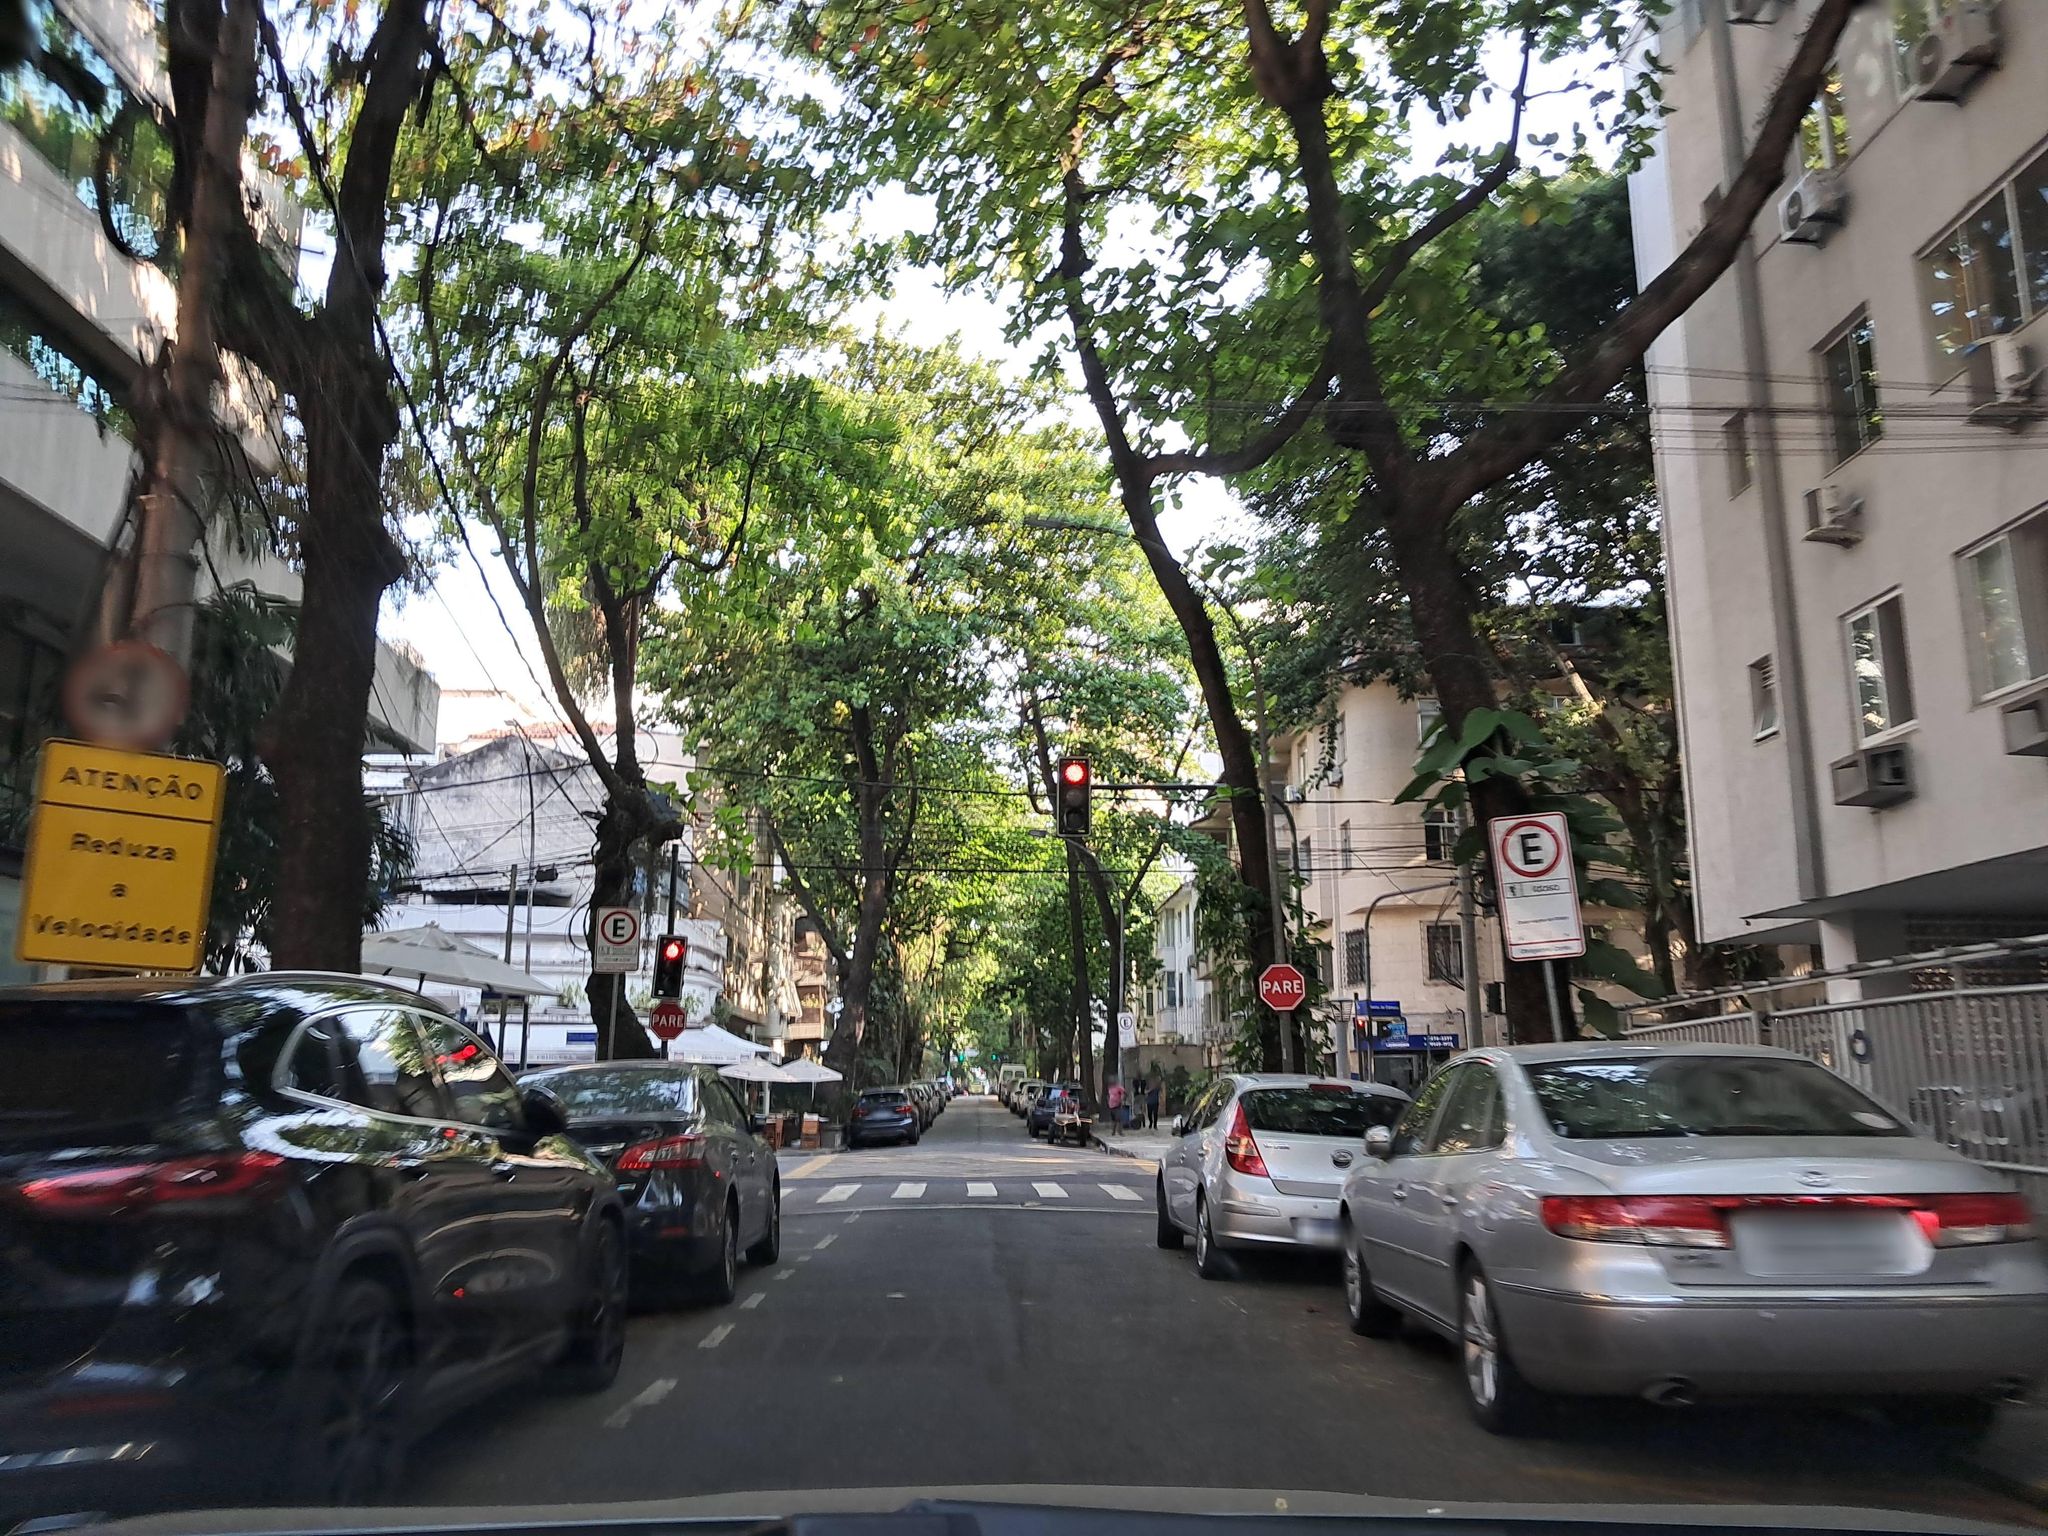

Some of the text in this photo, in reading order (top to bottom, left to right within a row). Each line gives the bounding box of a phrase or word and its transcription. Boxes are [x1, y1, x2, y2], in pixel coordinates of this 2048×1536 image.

[60, 766, 204, 800] ATENÇÃO
[71, 832, 177, 861] Reduza
[1519, 833, 1544, 865] E
[111, 882, 127, 898] a
[32, 914, 192, 945] Velocidade
[612, 918, 626, 938] E
[1262, 979, 1303, 995] PARE
[652, 1014, 684, 1028] PARE
